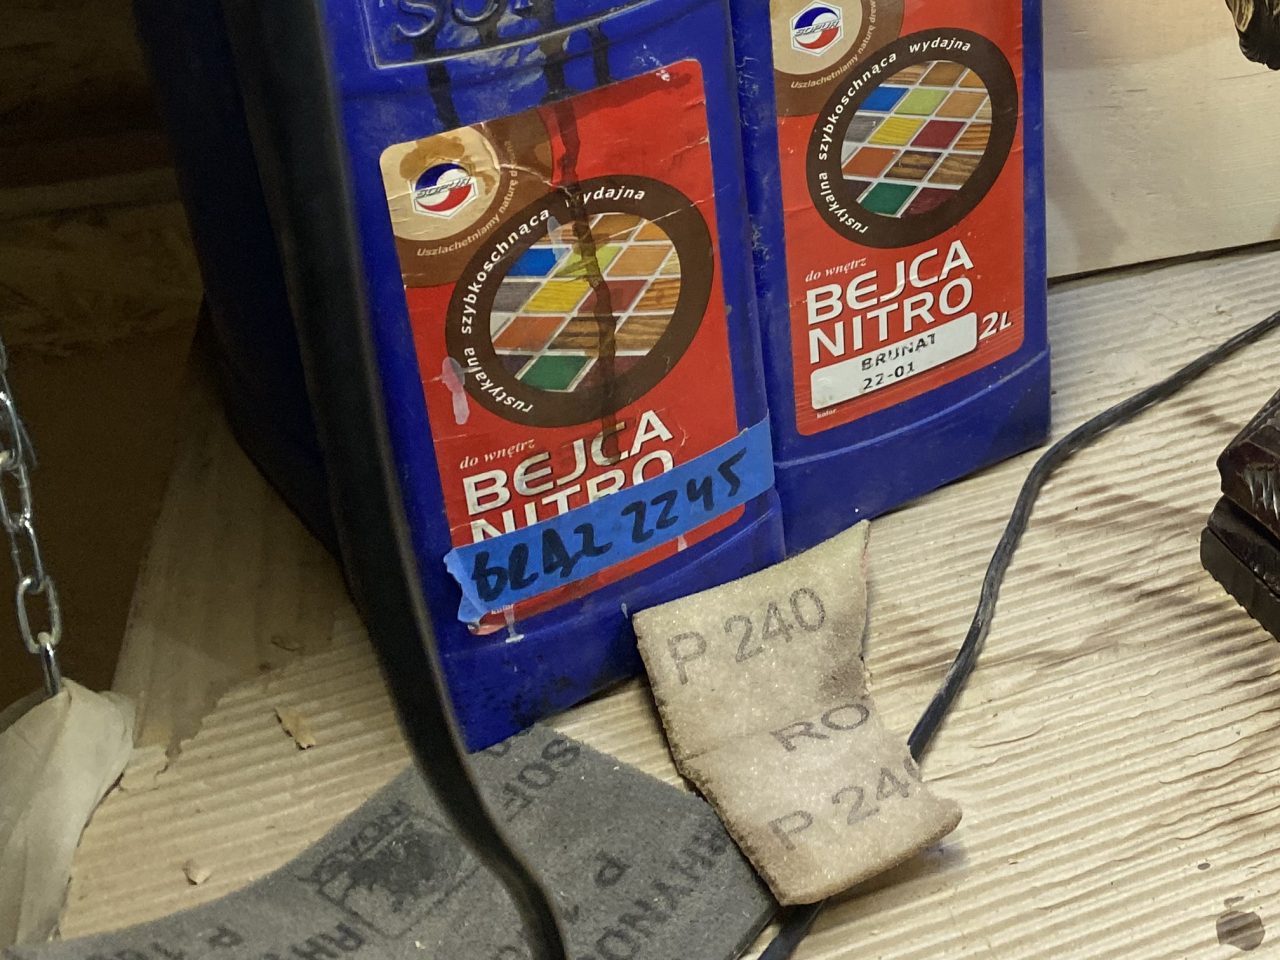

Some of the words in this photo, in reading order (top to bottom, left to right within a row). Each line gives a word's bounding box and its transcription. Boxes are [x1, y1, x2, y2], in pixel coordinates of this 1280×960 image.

[908, 37, 971, 54] wydajna
[818, 51, 899, 161] szybkoschnąca
[818, 171, 869, 235] rustykalna
[461, 208, 551, 335] szybkoschnąca
[805, 270, 821, 283] do
[824, 257, 867, 277] wnętrz
[806, 239, 974, 326] BEJCA
[808, 276, 974, 365] NITRO
[978, 310, 1014, 341] 2L
[861, 332, 937, 371] BRUNAT
[463, 347, 534, 413] rustykalna
[862, 361, 916, 390] 22-01
[459, 455, 480, 471] do
[483, 438, 537, 462] wnętrz
[462, 409, 674, 516] BEJCA
[621, 447, 747, 544] 2245
[666, 631, 706, 685] P
[725, 588, 826, 663] 240
[768, 810, 814, 851] P
